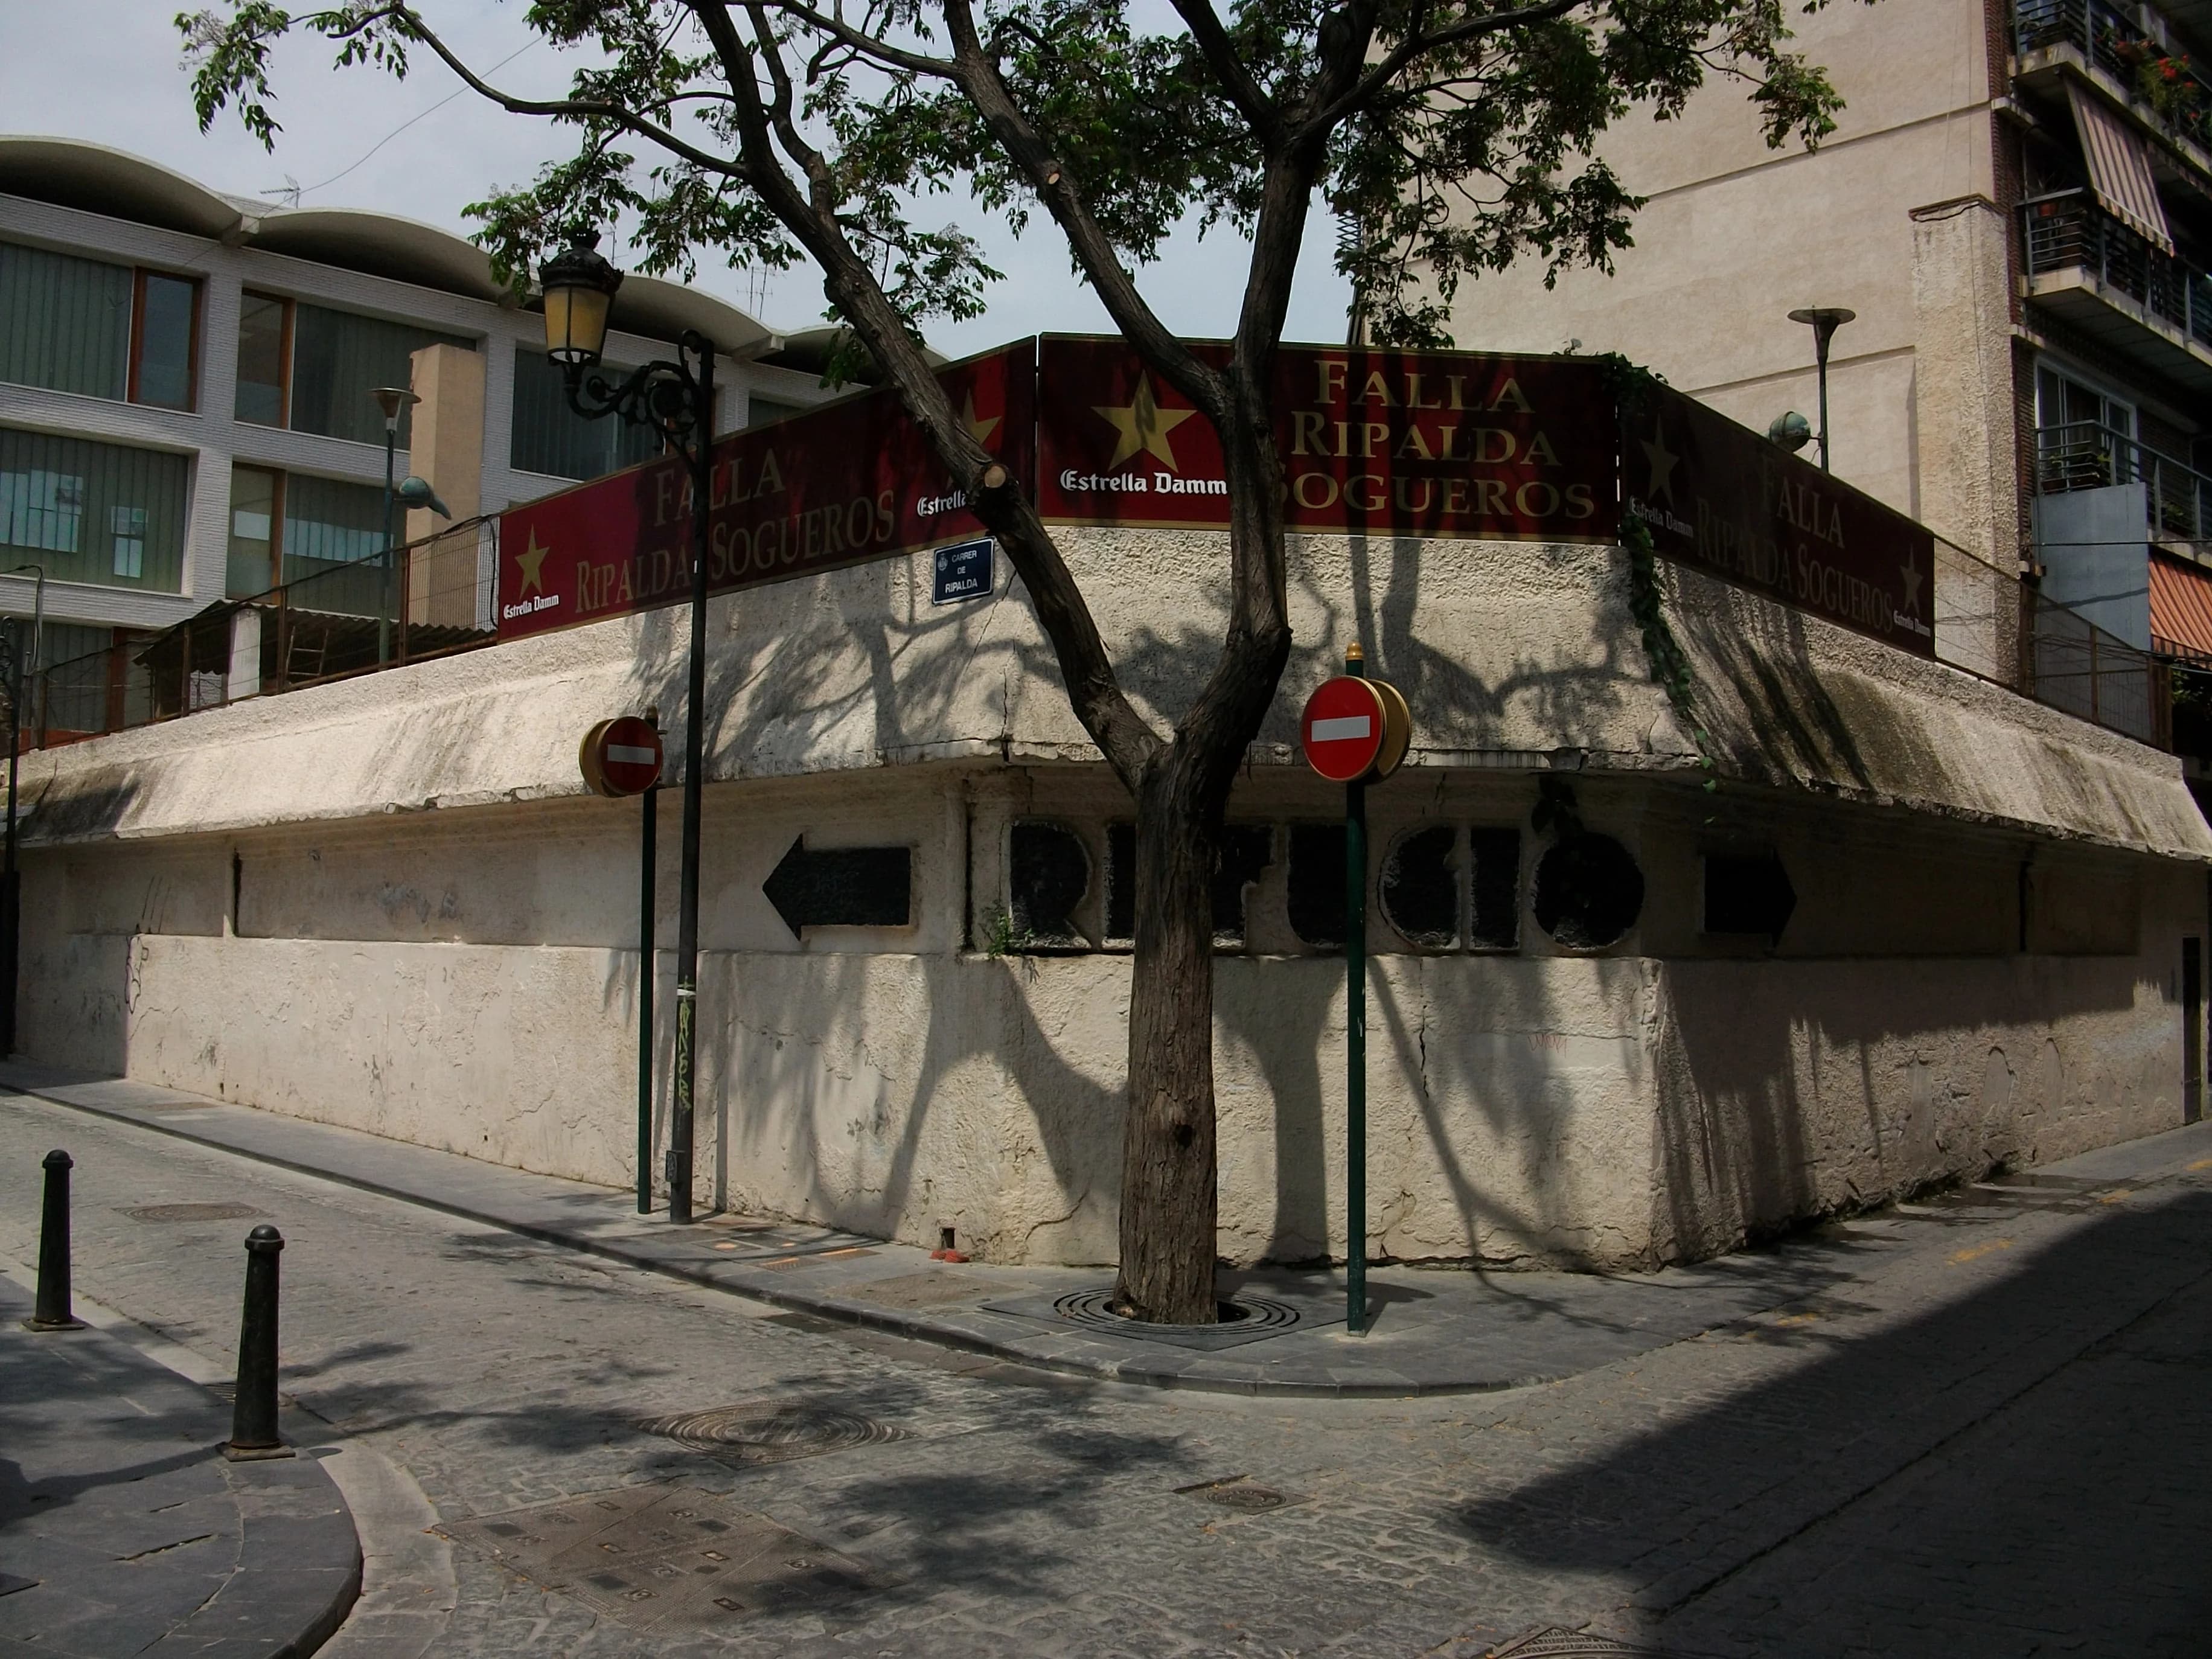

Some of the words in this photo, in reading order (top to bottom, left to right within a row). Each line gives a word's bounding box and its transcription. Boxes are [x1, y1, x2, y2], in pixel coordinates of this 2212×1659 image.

[1314, 359, 1536, 414] FALLA
[1290, 410, 1562, 467] RIPALDA
[654, 447, 785, 527] FALLA
[1060, 468, 1148, 492] Estrella
[1153, 471, 1228, 495] Damm
[1279, 471, 1595, 519] OGUEROS
[1762, 455, 1846, 549] FALLA
[1664, 509, 1694, 539] Damm
[575, 545, 692, 613] RIPALDA
[711, 489, 894, 581] SOGUEROS
[951, 549, 977, 563] CARRER
[957, 566, 966, 575] DE
[503, 599, 533, 620] Estrella
[533, 594, 560, 612] Damm
[944, 577, 978, 595] RIPALDA
[1797, 542, 1894, 634] SOGUEROS
